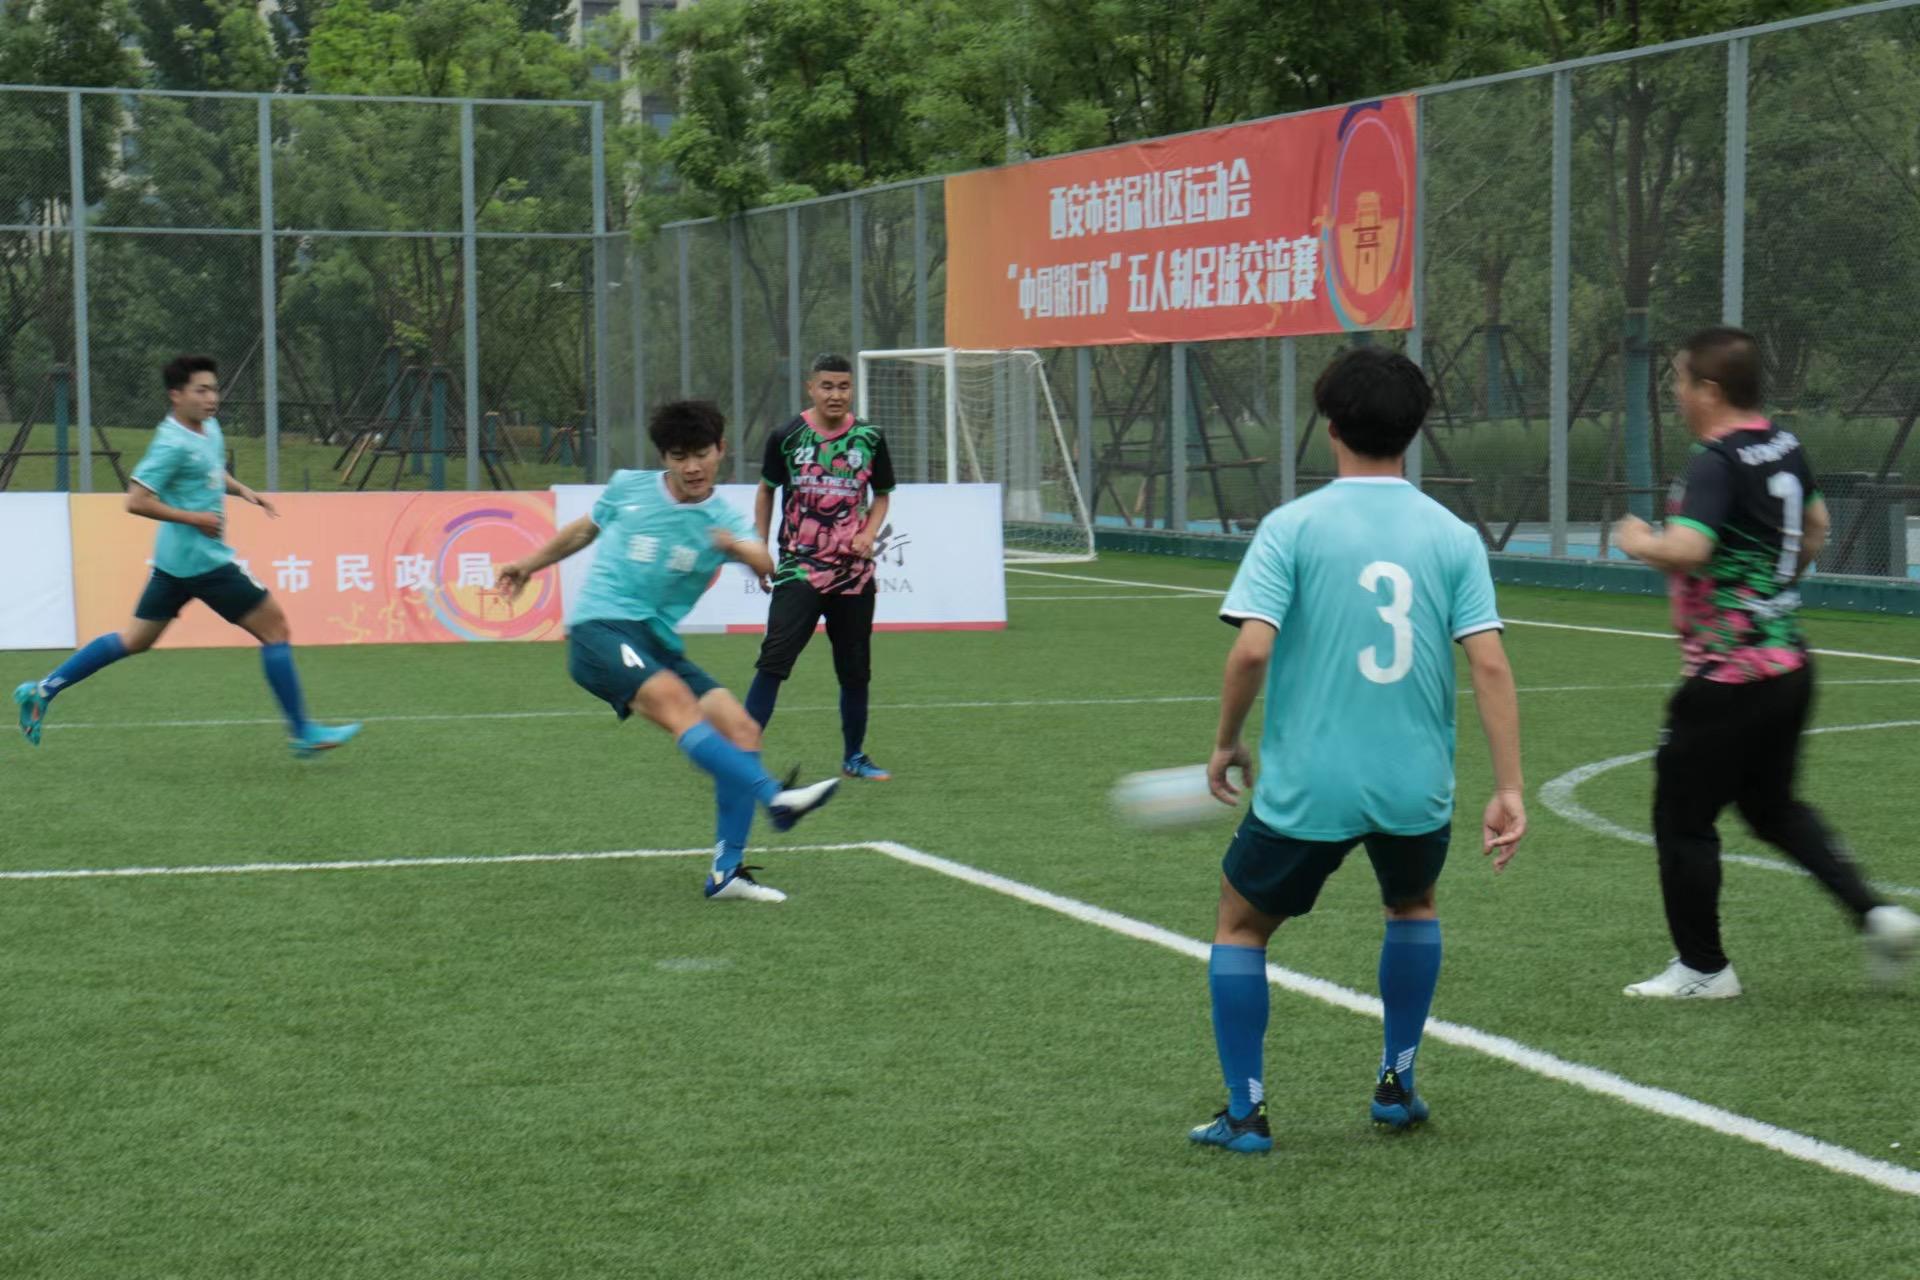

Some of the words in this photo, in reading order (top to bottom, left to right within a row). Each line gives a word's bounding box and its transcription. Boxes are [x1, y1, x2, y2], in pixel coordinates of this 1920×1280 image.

[1049, 157, 1250, 240] 西安市首届社区运动会
[793, 447, 817, 465] 22
[1766, 471, 1804, 584] 1
[146, 553, 495, 592] 市民政局
[1357, 560, 1413, 684] 3
[620, 643, 646, 669] 4
